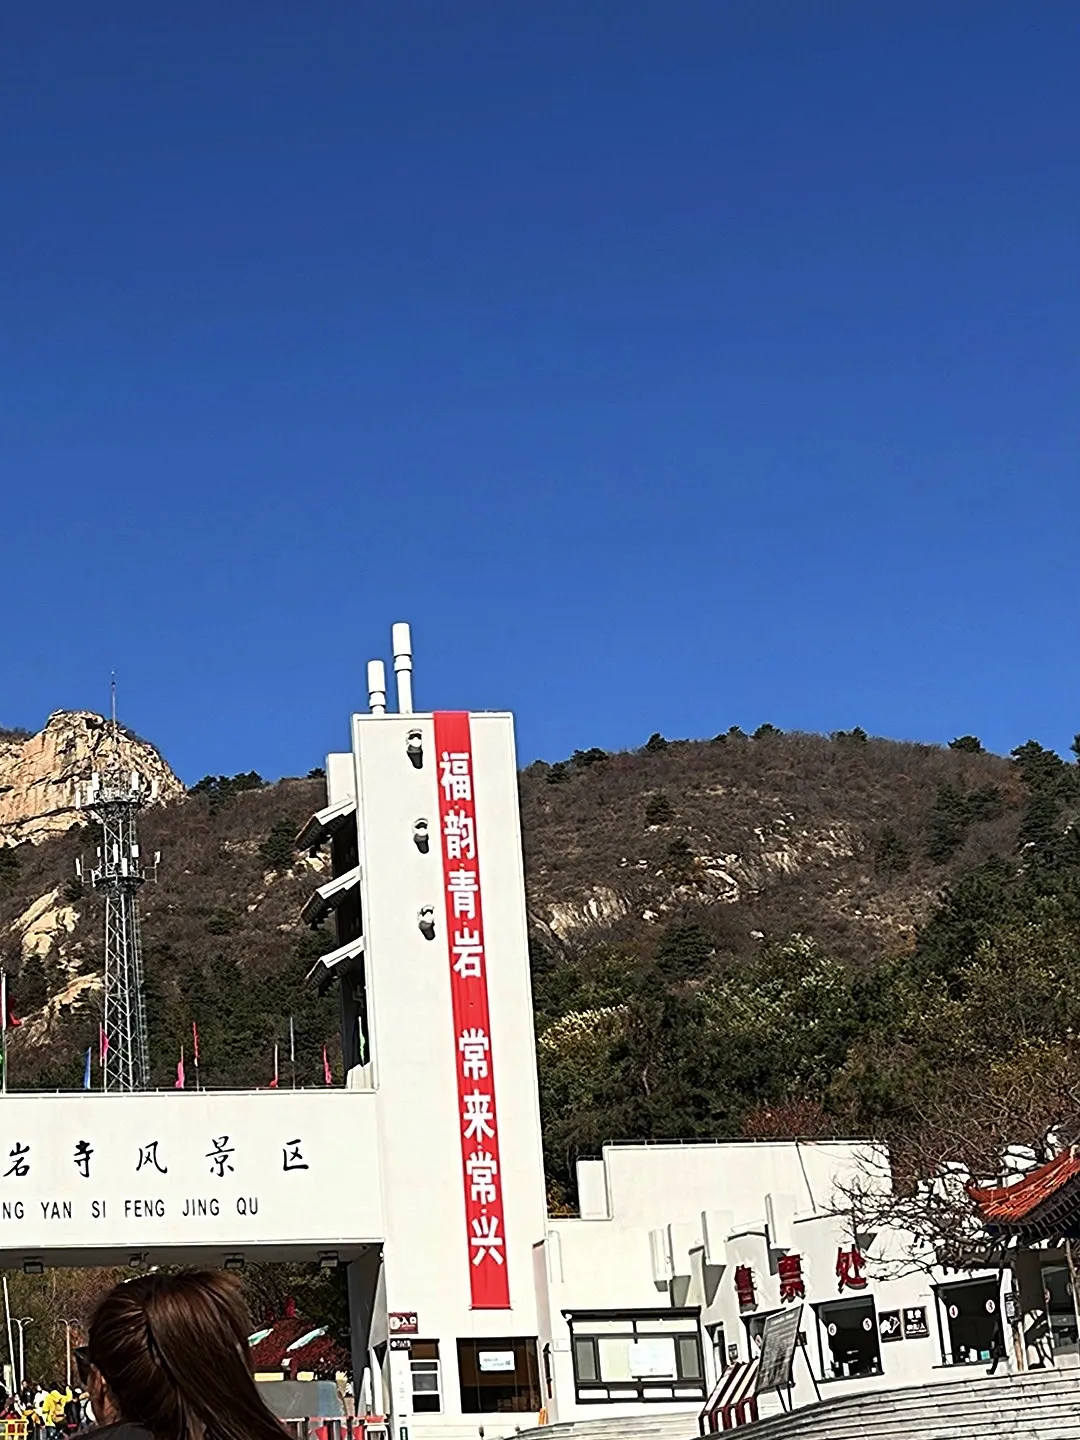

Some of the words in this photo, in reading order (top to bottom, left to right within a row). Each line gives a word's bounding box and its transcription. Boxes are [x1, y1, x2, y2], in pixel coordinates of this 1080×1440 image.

[439, 751, 483, 978] 福韵青岩
[40, 1200, 73, 1220] YAN
[91, 1199, 106, 1219] SI
[124, 1198, 166, 1218] FENG
[182, 1197, 220, 1217] JING
[236, 1196, 259, 1216] QU
[458, 1027, 504, 1266] 常来常兴
